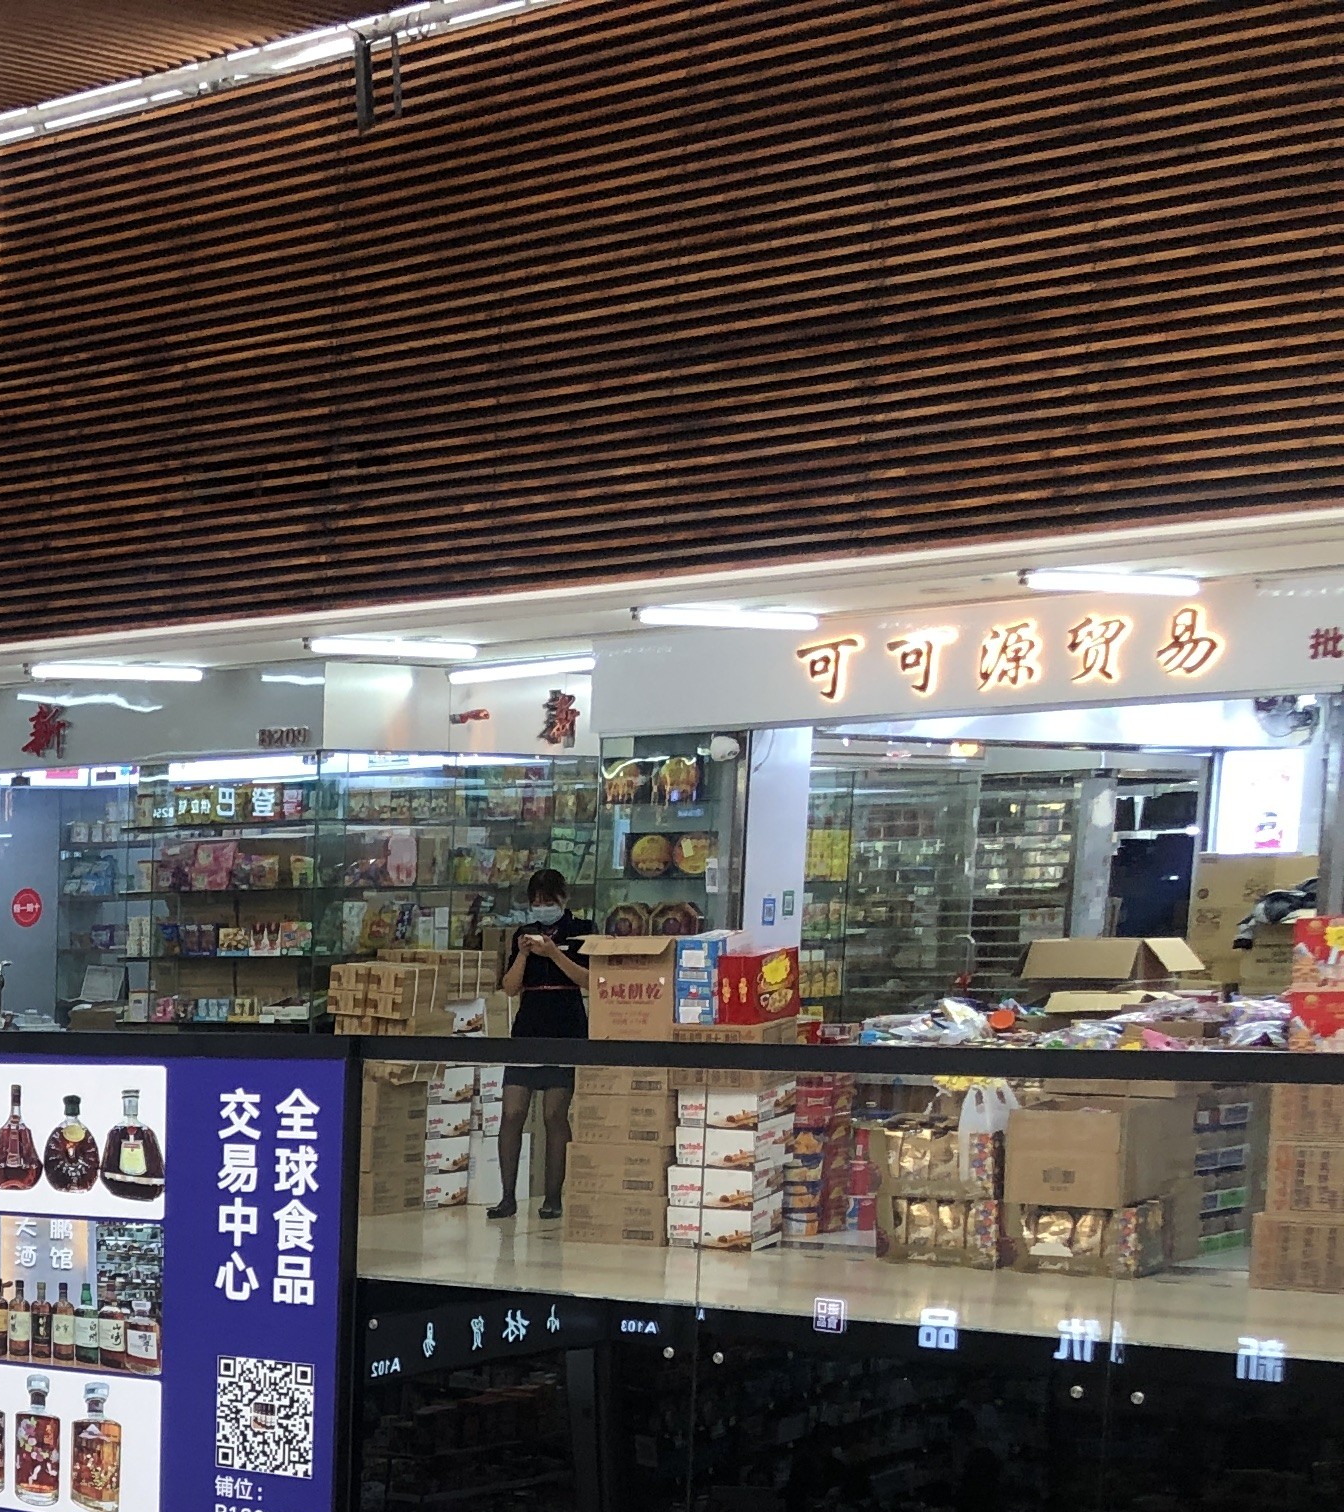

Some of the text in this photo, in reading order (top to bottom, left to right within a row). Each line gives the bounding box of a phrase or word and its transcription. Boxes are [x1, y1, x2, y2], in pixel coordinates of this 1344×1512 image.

[797, 606, 1222, 701] 可可源贸易
[14, 1245, 74, 1271] 酒馆
[214, 1090, 262, 1302] 交易中心
[274, 1088, 321, 1306] 全球食品
